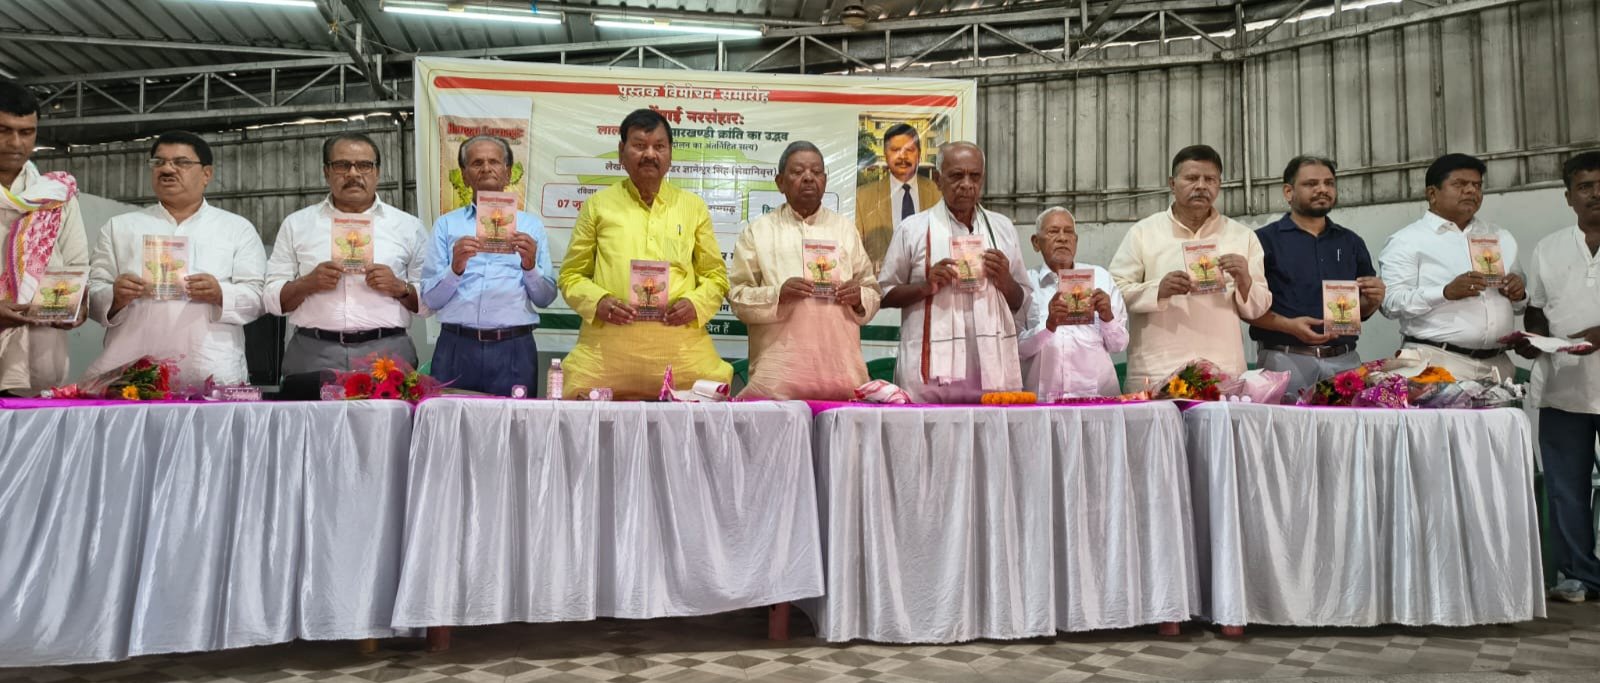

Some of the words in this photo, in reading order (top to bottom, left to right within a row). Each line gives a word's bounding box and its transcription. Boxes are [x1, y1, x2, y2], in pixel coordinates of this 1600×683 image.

[617, 84, 661, 101] पुस्तक
[663, 82, 716, 100] विमोचन
[719, 85, 770, 104] समारोह
[686, 108, 745, 126] नरसंहार:
[671, 126, 714, 138] ारखण्डी
[717, 126, 745, 141] क्रांति
[747, 131, 762, 141] का
[765, 131, 790, 143] उद्भव
[672, 141, 691, 150] दोलन
[557, 199, 570, 208] 07
[573, 200, 584, 211] जू
